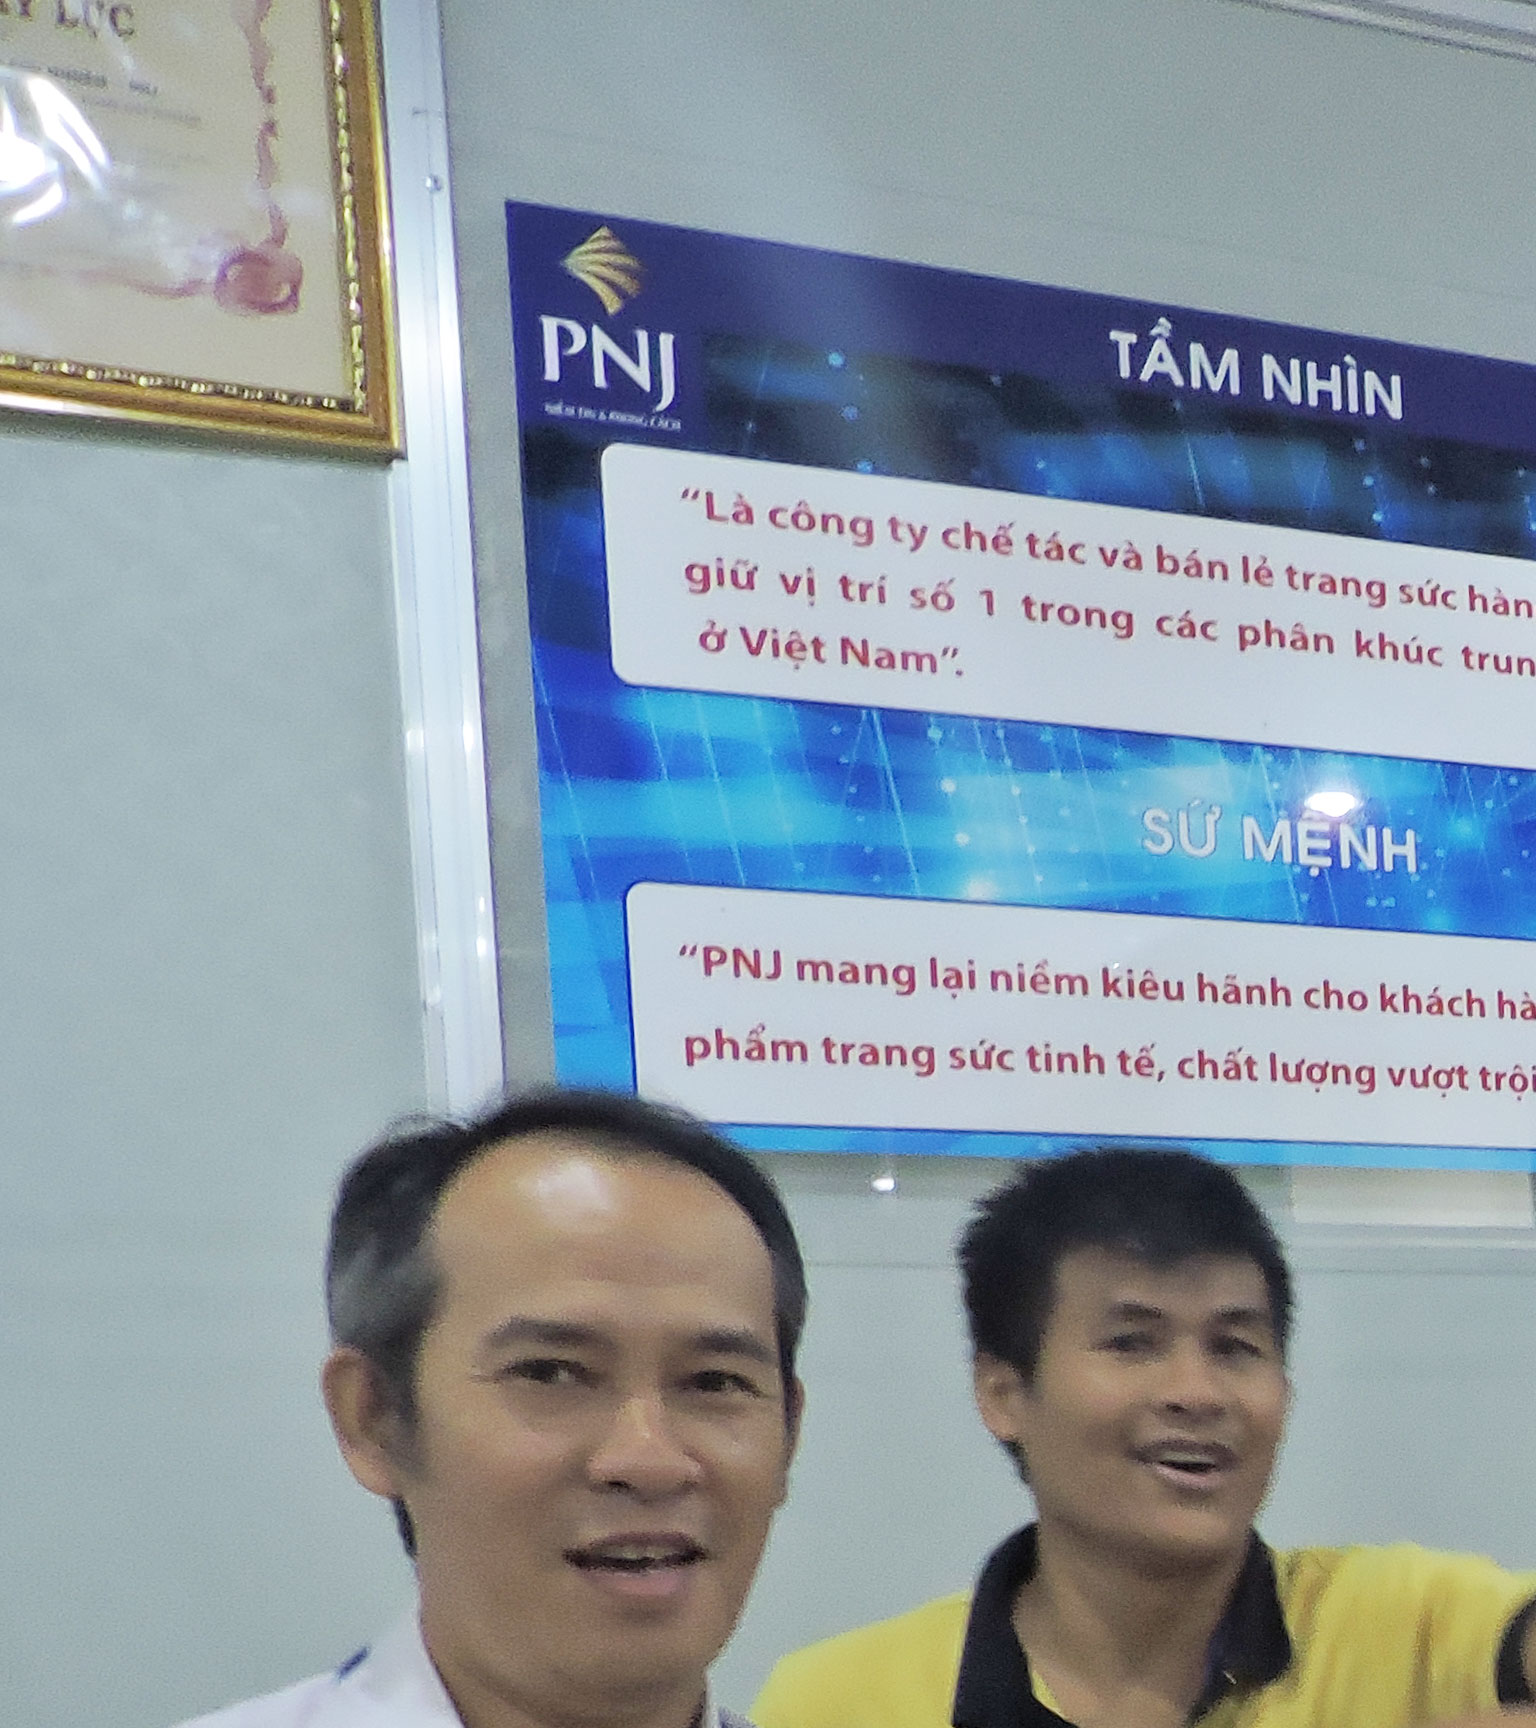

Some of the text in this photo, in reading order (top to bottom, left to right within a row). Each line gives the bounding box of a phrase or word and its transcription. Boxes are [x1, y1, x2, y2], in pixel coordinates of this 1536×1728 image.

[538, 314, 675, 412] PNJ
[1109, 317, 1403, 421] TẦM NHÌN
[768, 503, 874, 546] công
[889, 514, 927, 551] ty
[941, 522, 1013, 556] chế
[1026, 533, 1085, 566] tác
[1099, 540, 1144, 571] và
[1157, 545, 1228, 582] bán
[1242, 555, 1274, 586] lẻ
[1286, 564, 1386, 608] trang
[1400, 579, 1457, 610] sức
[684, 555, 757, 595] giữ
[780, 570, 816, 608] vị
[839, 573, 888, 606] trí
[909, 578, 955, 615] số
[980, 588, 996, 616] 1
[1021, 595, 1134, 639] trong
[1155, 610, 1220, 642] các
[1355, 630, 1443, 668] khúc
[699, 620, 728, 653] ở
[740, 625, 826, 670] Việt
[1142, 798, 1417, 877] SỨ MỆNH
[796, 957, 916, 996] mang
[929, 955, 976, 1002] lại
[989, 960, 1088, 998] niềm
[1102, 964, 1184, 1004] kiêu
[1197, 970, 1292, 1010] hãnh
[1303, 978, 1368, 1012] cho
[1380, 984, 1486, 1020] khách
[684, 1020, 809, 1068] phẩm
[822, 1034, 937, 1078] trang
[948, 1038, 1015, 1074] sức
[1026, 1042, 1107, 1077] tinh
[1117, 1045, 1167, 1084] tế,
[1177, 1045, 1258, 1086] chất
[1269, 1050, 1377, 1095] lượng
[1388, 1060, 1469, 1100] vượt
